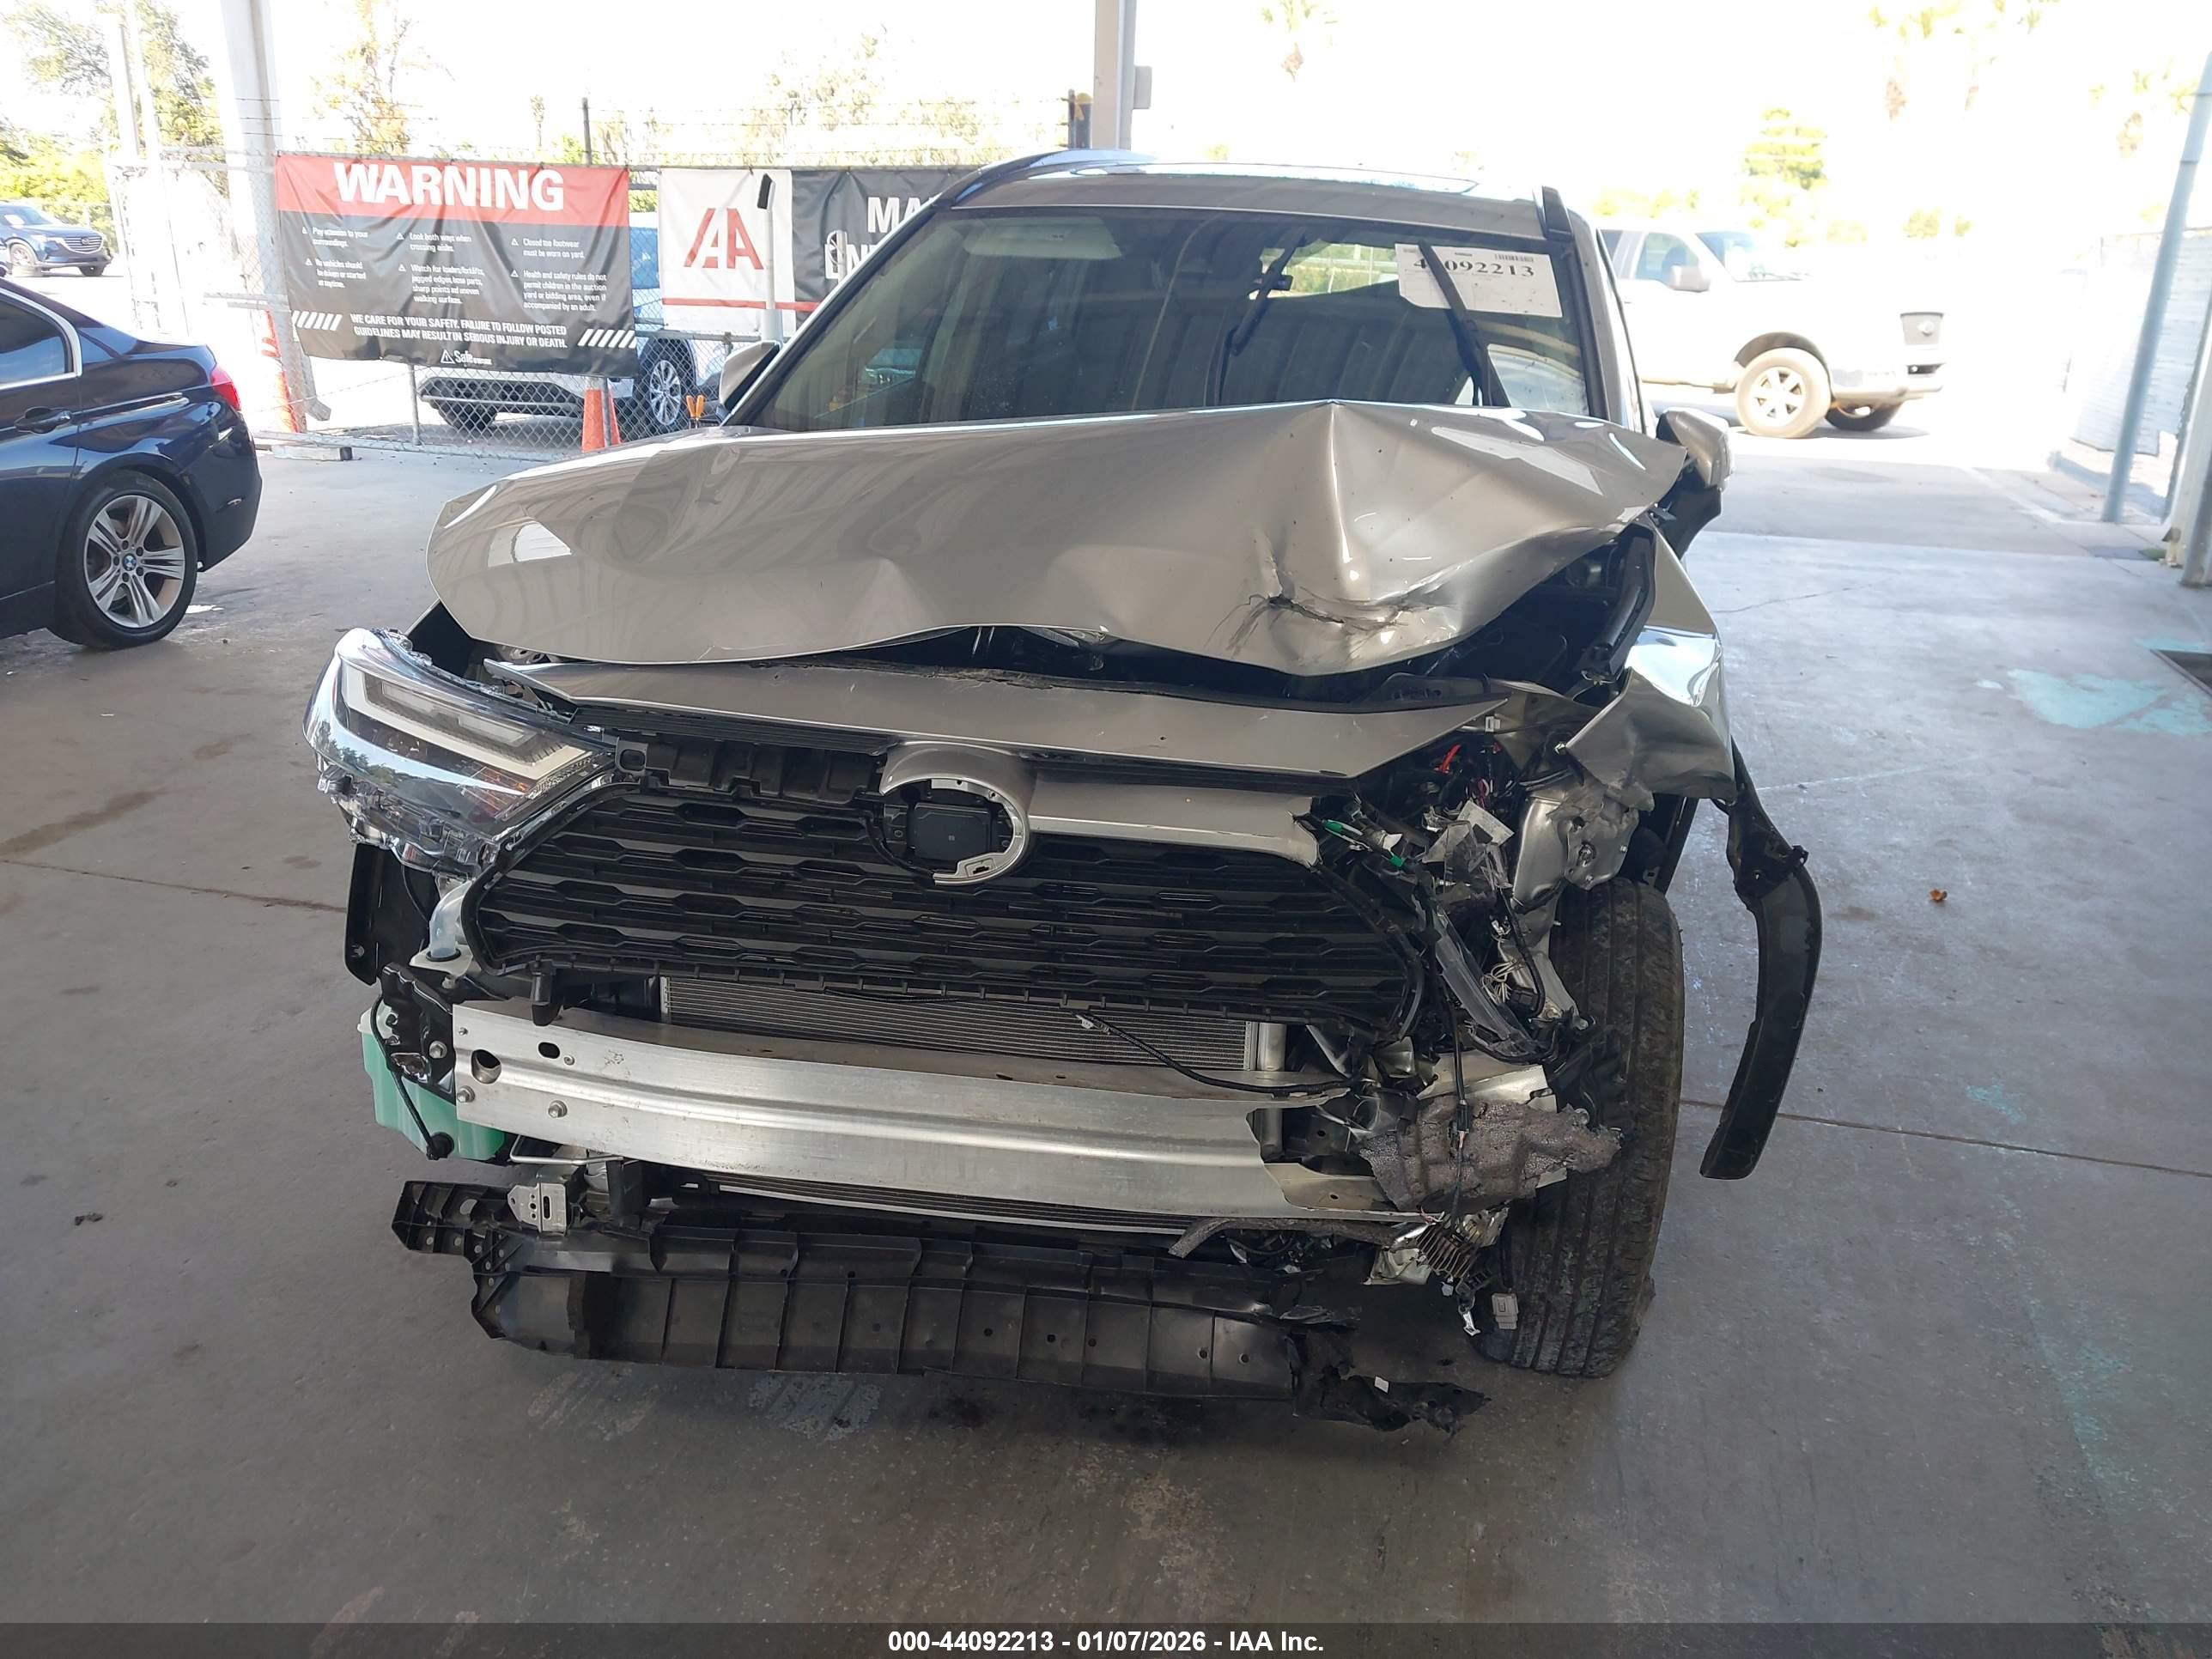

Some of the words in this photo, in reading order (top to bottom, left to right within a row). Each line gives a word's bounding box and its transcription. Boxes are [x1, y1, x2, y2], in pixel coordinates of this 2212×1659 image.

[333, 161, 564, 211] WARNING
[553, 239, 580, 248] footwear
[410, 264, 432, 273] Watch
[1413, 258, 1534, 277] 4092213
[523, 270, 541, 278] Health
[553, 271, 571, 281] safety
[412, 284, 430, 293] sharp
[431, 285, 450, 294] points
[413, 295, 437, 304] walking
[545, 292, 566, 301] bidding
[562, 303, 570, 311] by
[349, 313, 364, 324] WE
[364, 314, 387, 325] CARE
[386, 316, 404, 326] FOR
[404, 316, 427, 327] YOUR
[428, 318, 460, 329] SAFETY.
[460, 319, 491, 330] FAILURE
[491, 321, 502, 331] TO
[502, 322, 534, 334] FOLLOW
[535, 325, 567, 335] POSTED
[353, 326, 401, 338] GUIDELINES
[401, 329, 421, 339] MAY
[421, 330, 453, 341] RESULT
[453, 331, 463, 341] IN
[496, 334, 525, 345] INJURY
[526, 336, 538, 346] OR
[538, 337, 568, 348] DEATH.
[454, 350, 473, 363] Safe
